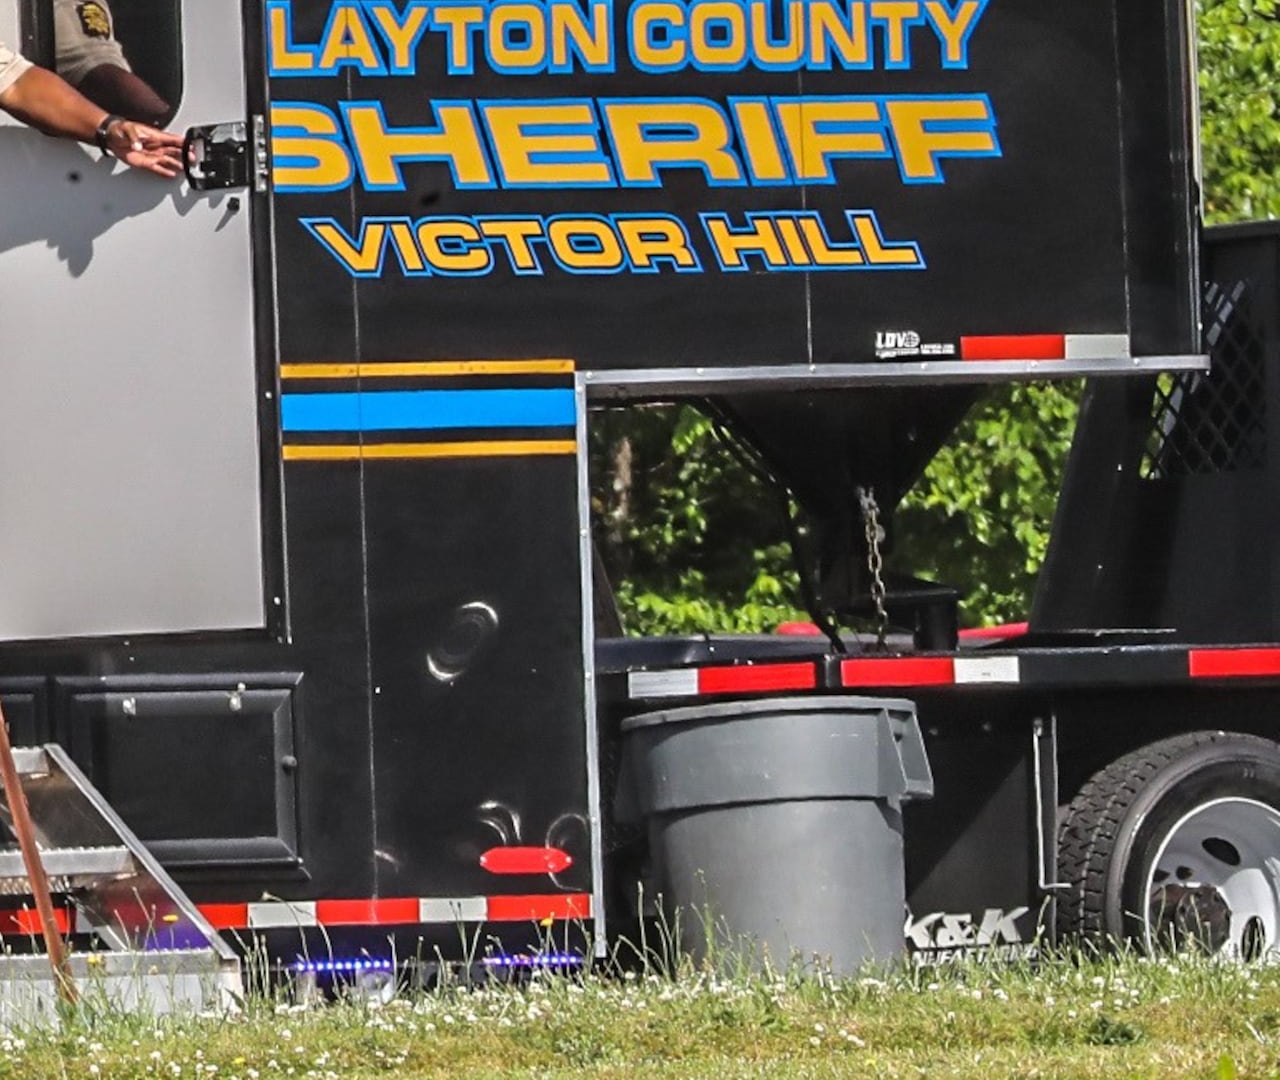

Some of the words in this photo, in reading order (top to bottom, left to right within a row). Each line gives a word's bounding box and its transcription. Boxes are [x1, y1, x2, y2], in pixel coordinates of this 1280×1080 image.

[270, 93, 1002, 193] SHERIFF
[299, 212, 703, 278] VICTOR
[698, 210, 927, 271] HILL
